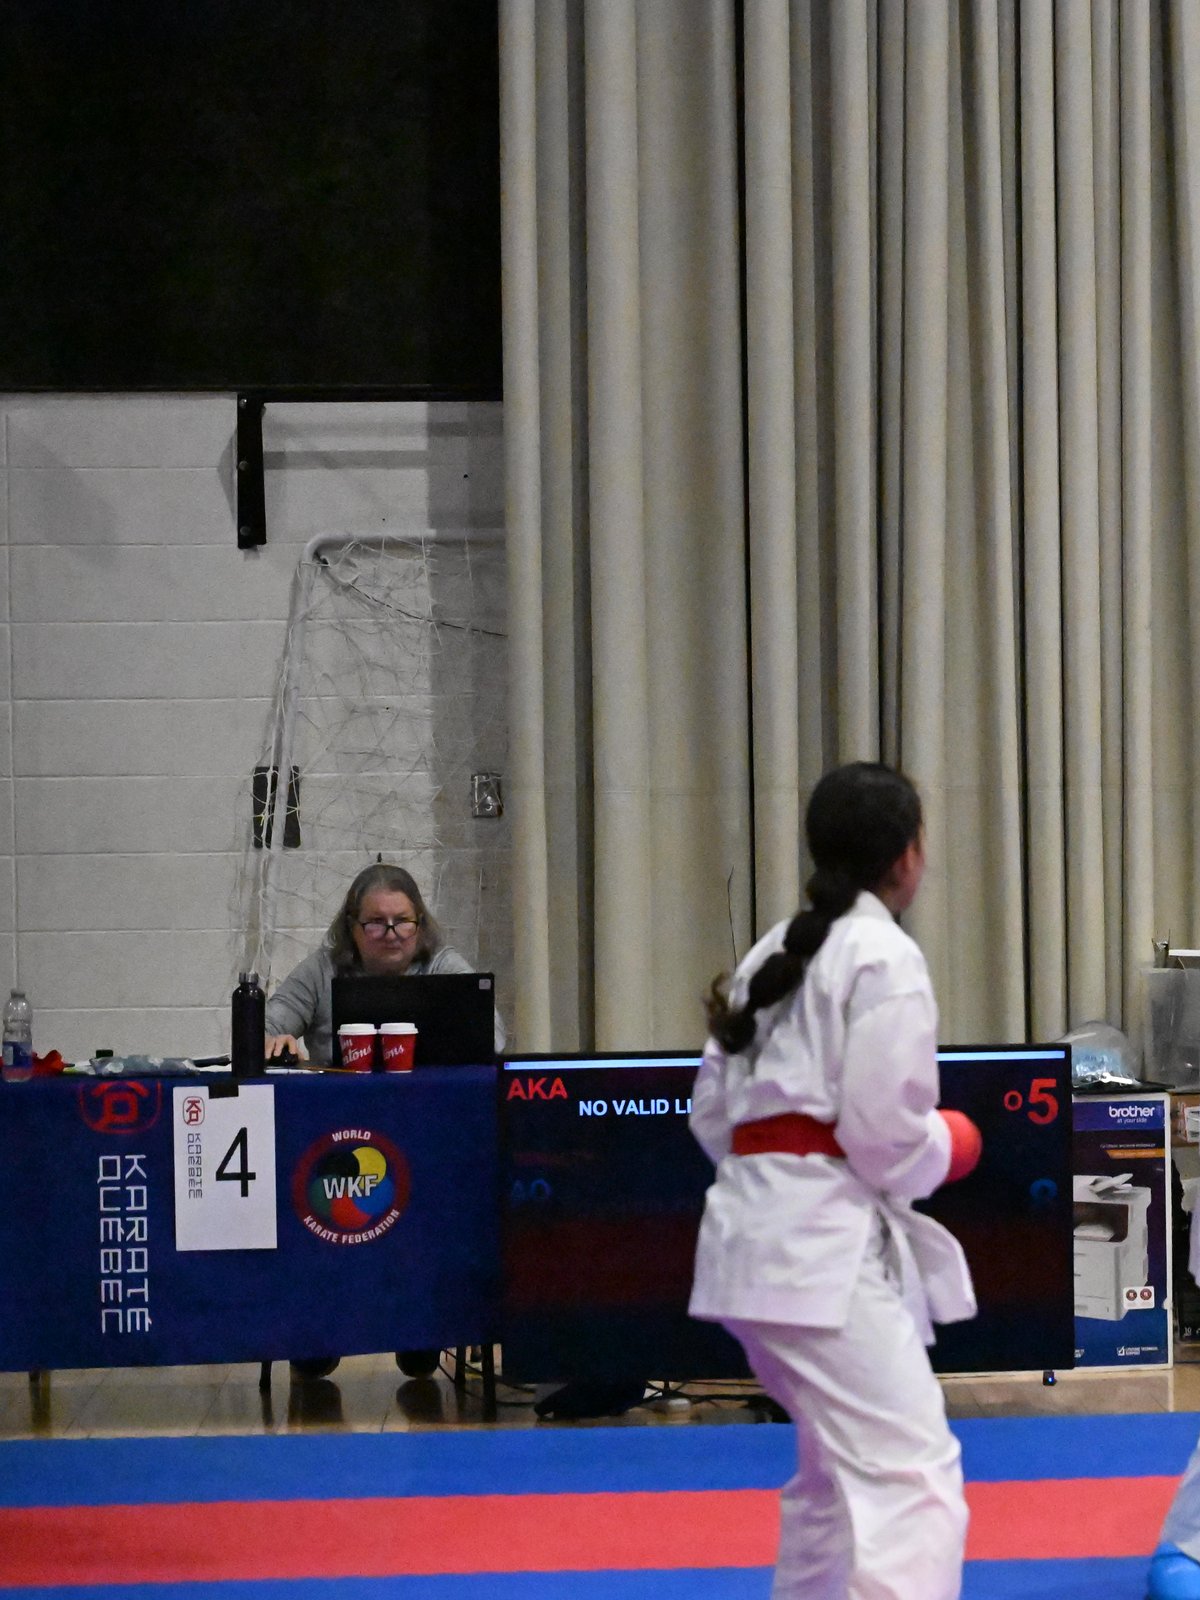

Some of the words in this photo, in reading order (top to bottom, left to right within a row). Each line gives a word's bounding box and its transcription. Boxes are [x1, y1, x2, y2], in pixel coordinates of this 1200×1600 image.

[507, 1077, 568, 1100] AKA
[579, 1100, 608, 1116] NO
[612, 1099, 670, 1116] VALID
[675, 1098, 692, 1115] LI
[1027, 1078, 1059, 1125] 5
[1109, 1105, 1155, 1118] brother
[332, 1129, 371, 1142] WORLD
[216, 1126, 256, 1197] 4
[323, 1175, 378, 1199] WKF
[303, 1215, 340, 1243] KARATE
[341, 1209, 400, 1244] FEDERATION
[97, 1155, 124, 1334] QUÉBEC
